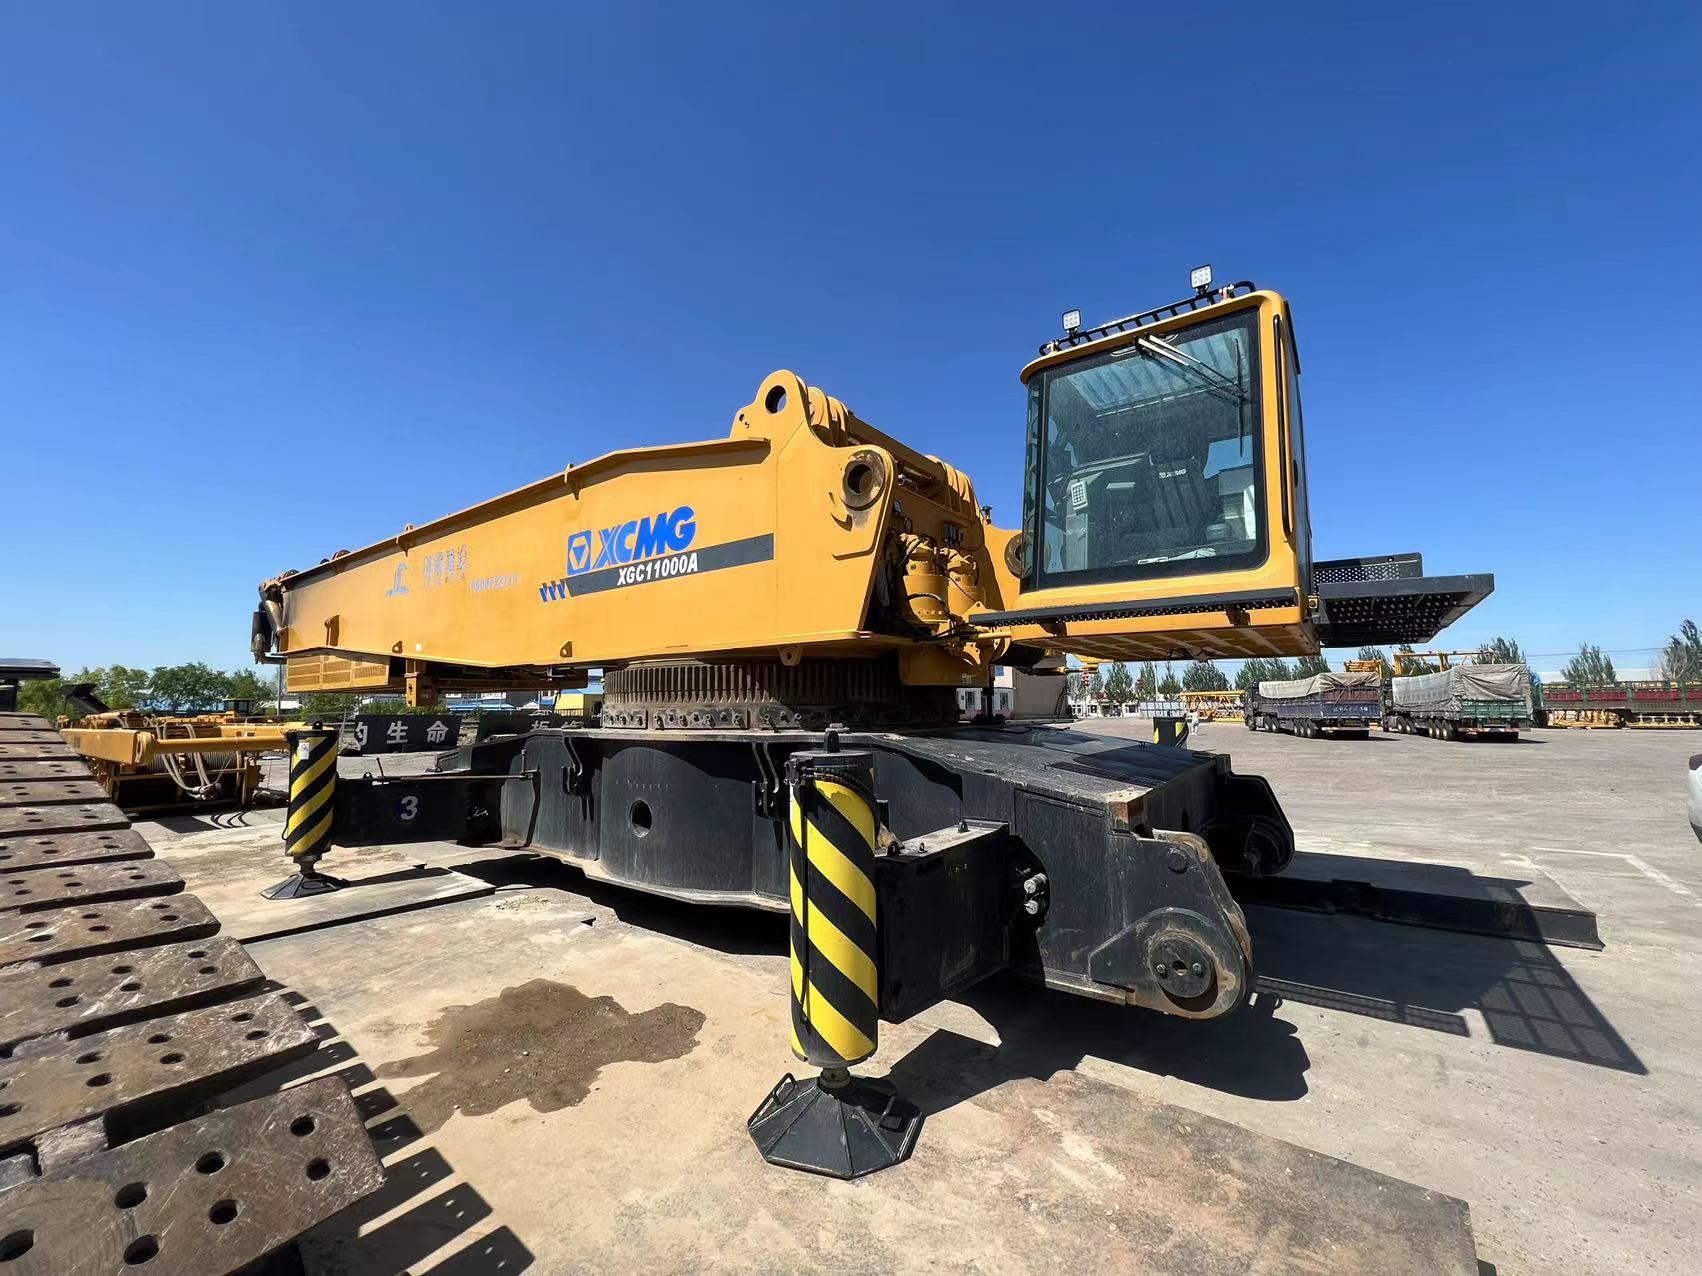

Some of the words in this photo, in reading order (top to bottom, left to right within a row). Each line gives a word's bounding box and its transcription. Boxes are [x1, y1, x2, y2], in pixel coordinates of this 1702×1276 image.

[592, 505, 697, 569] XCMG
[617, 552, 698, 586] XGC11000A
[400, 795, 418, 820] 3
